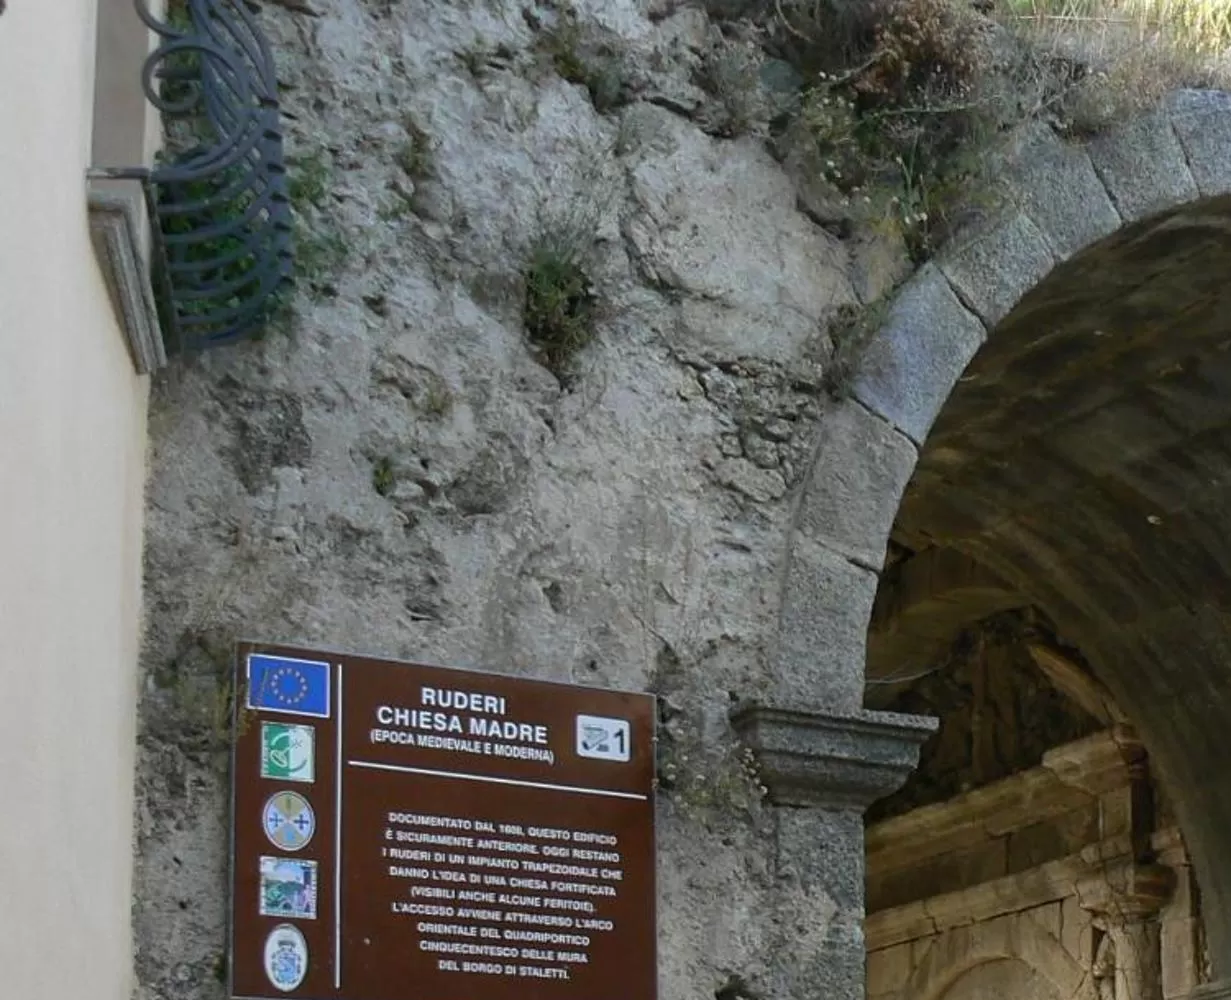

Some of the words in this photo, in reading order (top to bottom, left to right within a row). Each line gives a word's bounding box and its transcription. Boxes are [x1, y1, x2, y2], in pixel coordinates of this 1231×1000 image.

[422, 687, 505, 715] RUDERI
[377, 706, 463, 733] CHIESA
[469, 718, 548, 744] MADRE
[370, 728, 414, 746] (EPOCA
[417, 735, 481, 756] MEDIEVALE
[483, 743, 491, 755] E
[494, 744, 554, 766] MODERNA)
[613, 728, 625, 754] 1
[388, 812, 472, 830] DOCUMENTATO
[474, 820, 496, 833] DAL
[528, 827, 570, 841] QUESTO
[573, 832, 618, 846] EDIFICIO
[385, 827, 393, 840] È
[396, 830, 474, 849] SICURAMENTE
[477, 838, 540, 855] ANTERIORE.
[543, 845, 570, 856] OGGI
[572, 849, 620, 863] RESTANO
[382, 847, 387, 857] I
[390, 849, 431, 862] RUDERI
[434, 853, 446, 863] DI
[449, 854, 465, 865] UN
[468, 856, 519, 870] IMPIANTO
[522, 860, 599, 879] TRAPEZOIDALE
[601, 869, 623, 881] CHE
[389, 866, 429, 879] DANNO
[432, 869, 466, 883] L'IDEA
[469, 873, 481, 884] DI
[484, 875, 507, 886] UNA
[509, 877, 548, 891] CHIESA
[551, 881, 617, 897] FORTIFICATA
[410, 885, 456, 899] (VISIBILI
[458, 890, 496, 903] ANCHE
[499, 894, 541, 908] ALCUNE
[392, 902, 454, 917] L'ACCESSO
[457, 907, 502, 921] AVVIENE
[504, 912, 573, 927] ATTRAVERSO
[575, 917, 614, 931] L'ARCO
[417, 922, 478, 937] ORIENTALE
[480, 927, 502, 938] DEL
[504, 929, 590, 946] QUADRIPORTICO
[419, 940, 519, 958] CINQUECENTESCO
[521, 948, 556, 961] DELLE
[557, 952, 589, 964] MURA
[438, 959, 460, 972] DEL
[462, 961, 503, 974] BORGO
[505, 965, 516, 976] DI
